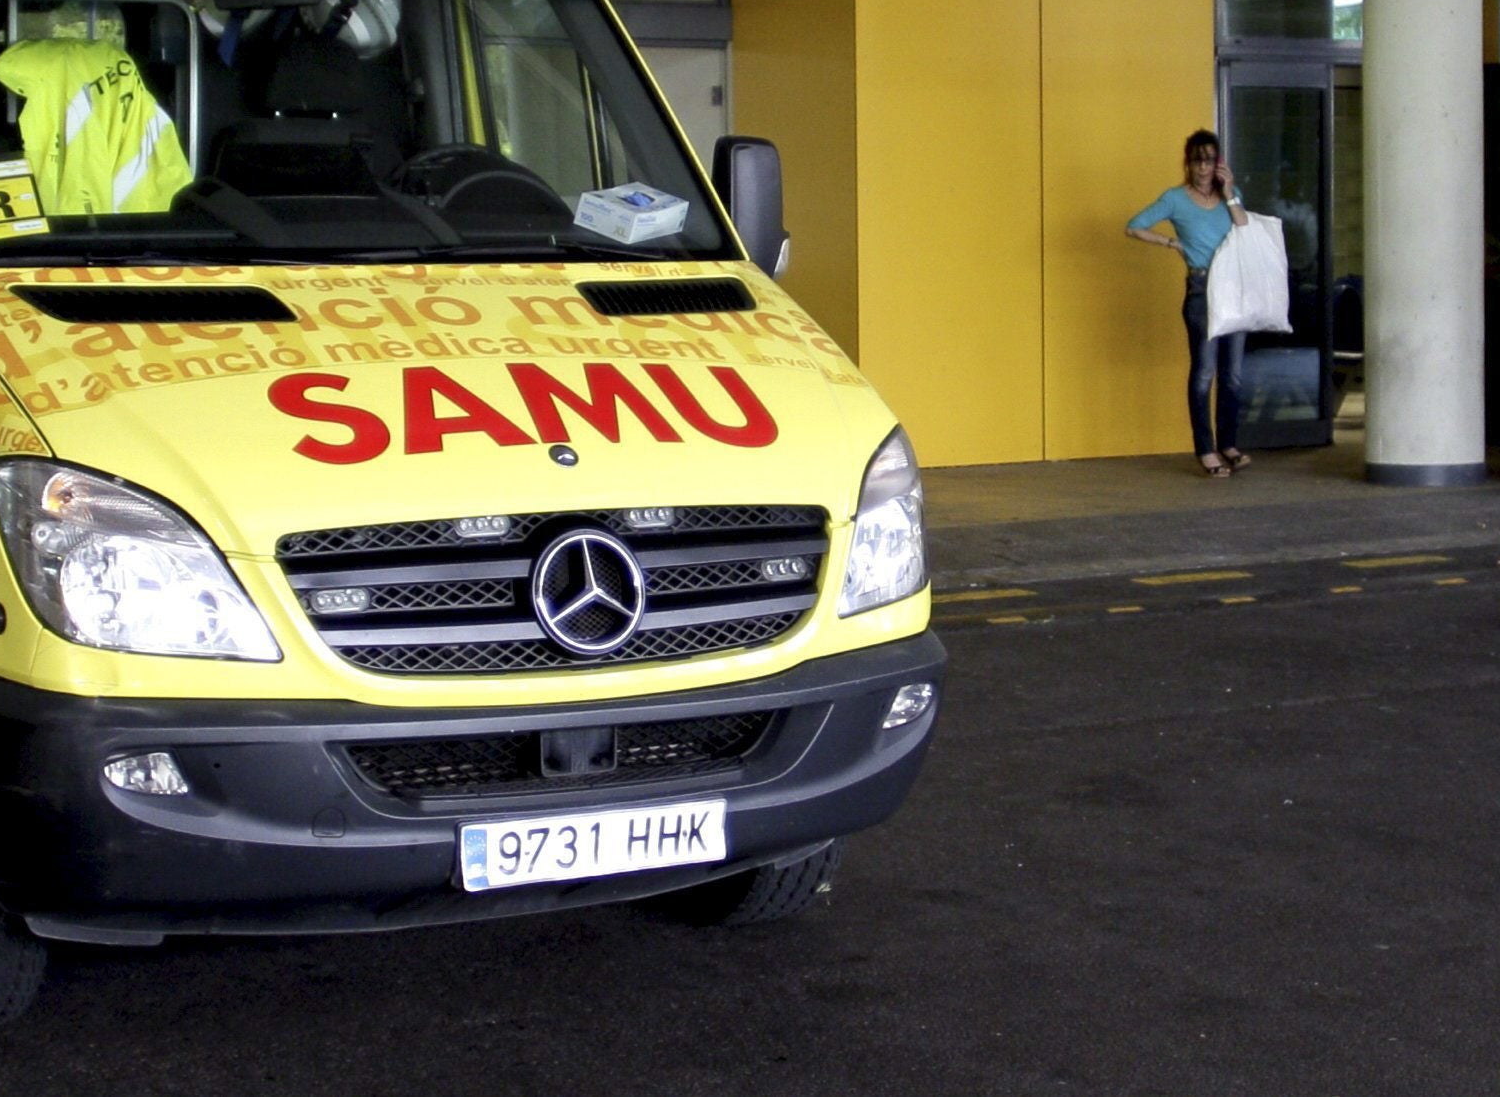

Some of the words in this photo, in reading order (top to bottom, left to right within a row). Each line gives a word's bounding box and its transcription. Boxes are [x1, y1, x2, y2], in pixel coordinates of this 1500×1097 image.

[271, 276, 388, 293] urgent
[24, 339, 308, 417] d'atenció
[323, 333, 534, 363] mèdica
[549, 335, 726, 361] urgent
[267, 362, 780, 465] SAMU
[498, 821, 601, 876] 9731
[626, 810, 711, 863] HHK
